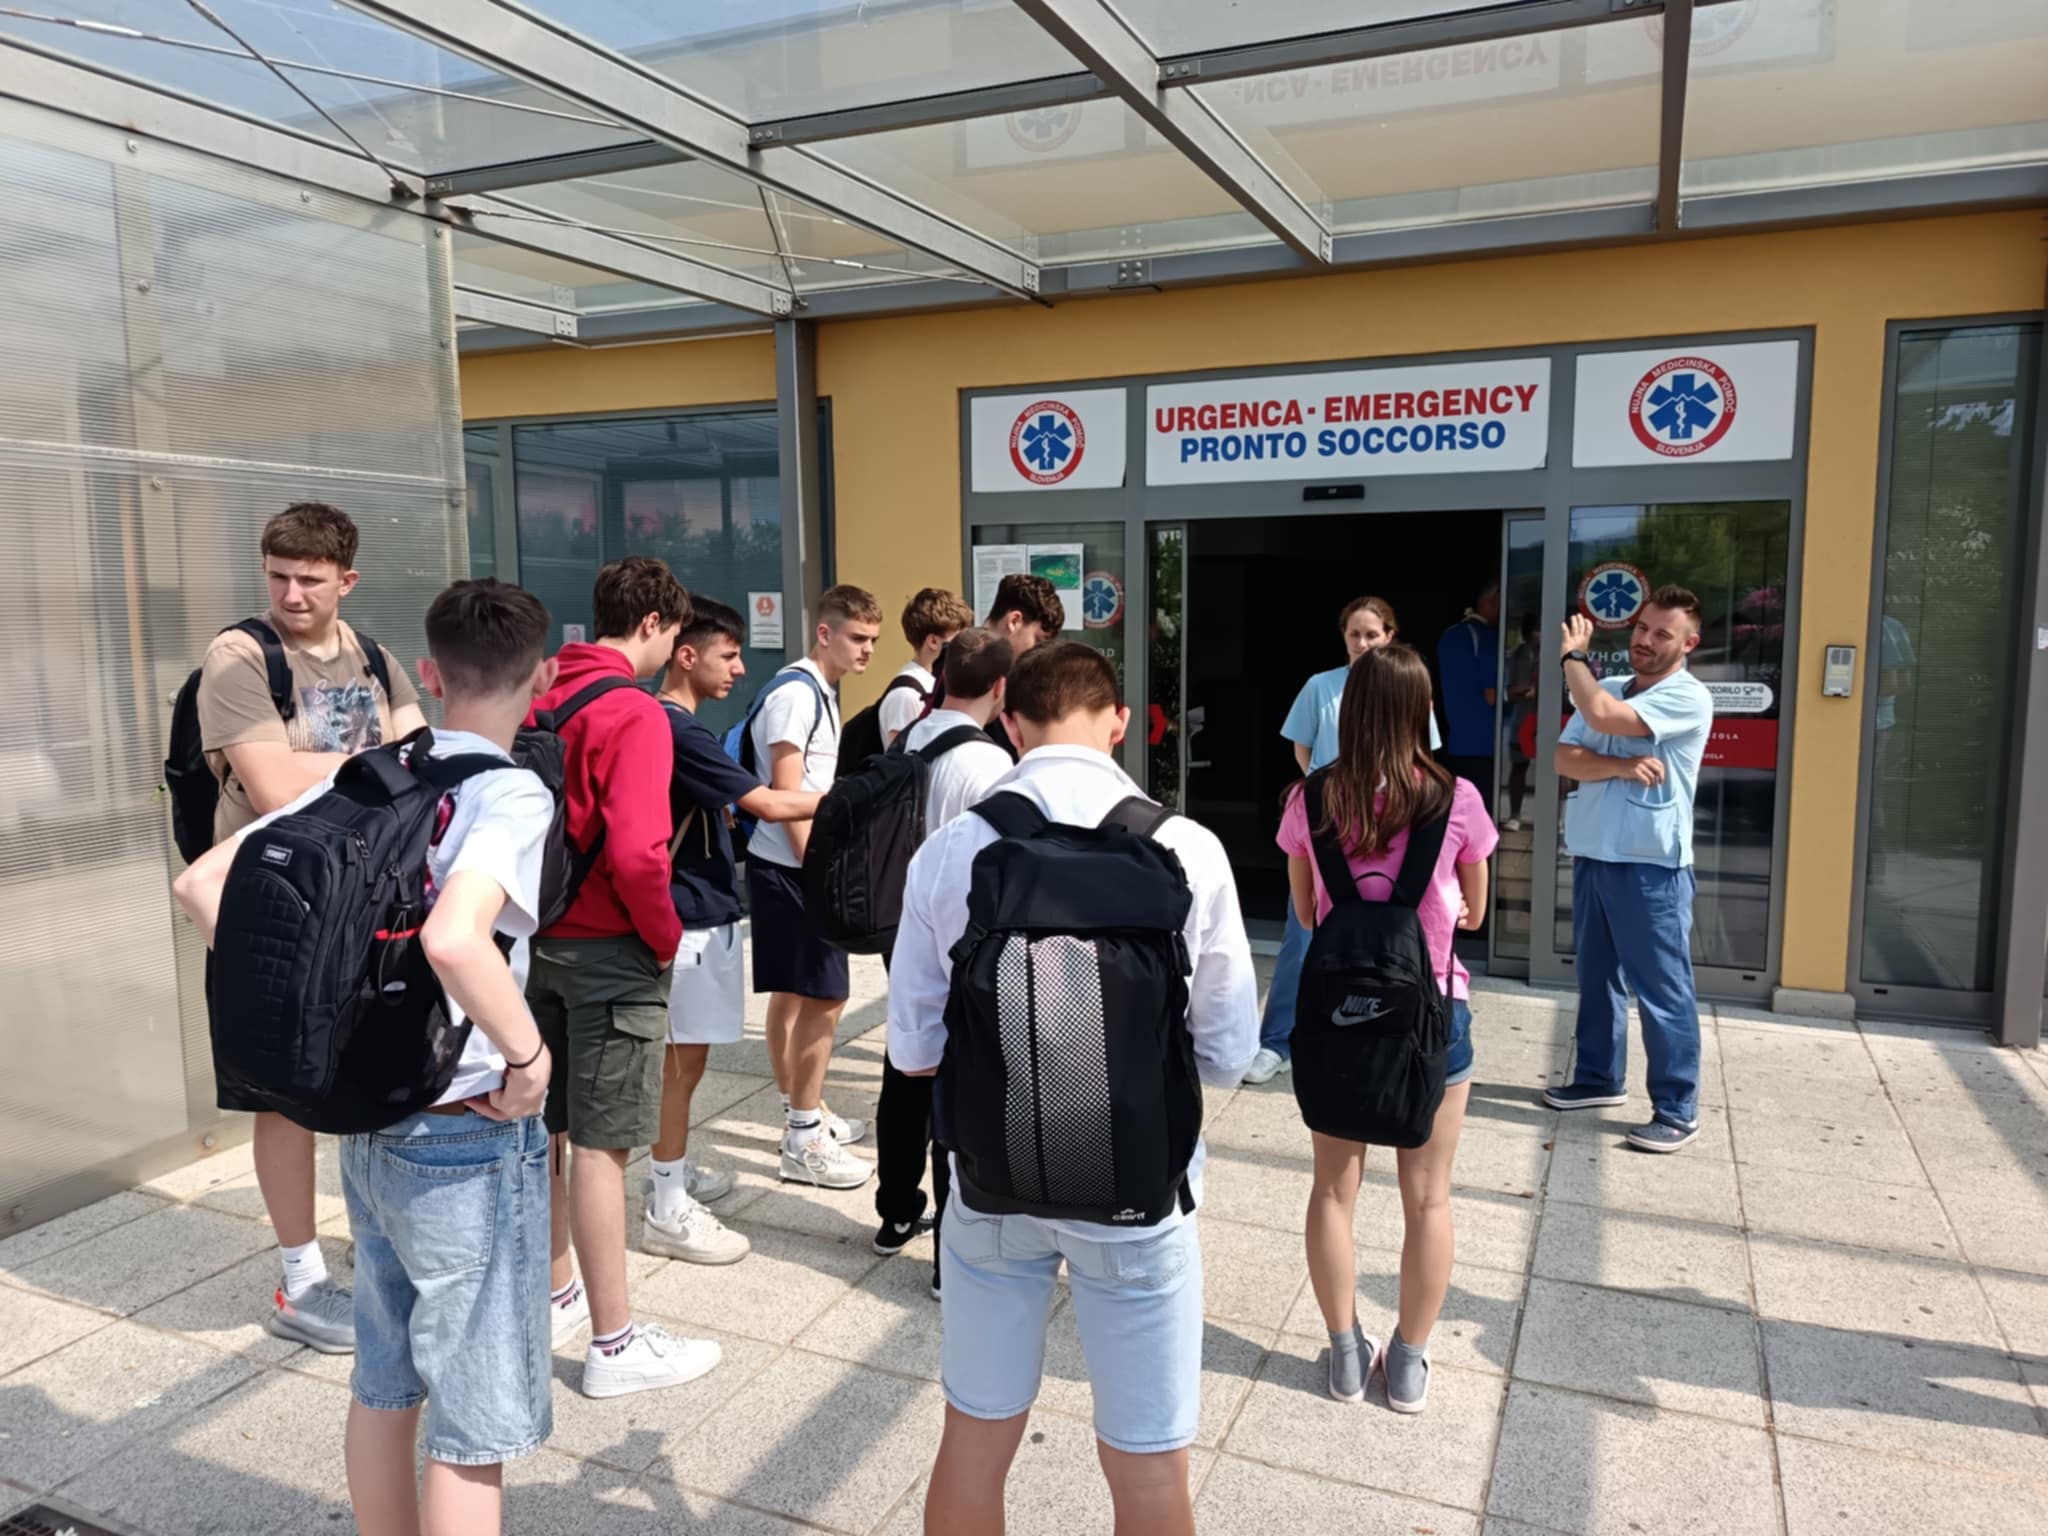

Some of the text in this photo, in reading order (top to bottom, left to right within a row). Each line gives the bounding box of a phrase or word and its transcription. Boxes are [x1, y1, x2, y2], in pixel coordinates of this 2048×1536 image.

[1632, 381, 1649, 413] NUJNA
[1652, 359, 1717, 377] MEDICINSKA
[1155, 400, 1303, 433] URGENCA
[1323, 384, 1539, 424] EMERGENCY
[1180, 421, 1506, 463] PRONTO SOCCORSO
[1711, 732, 1739, 740] ZOLA
[1341, 995, 1381, 1014] NIKE
